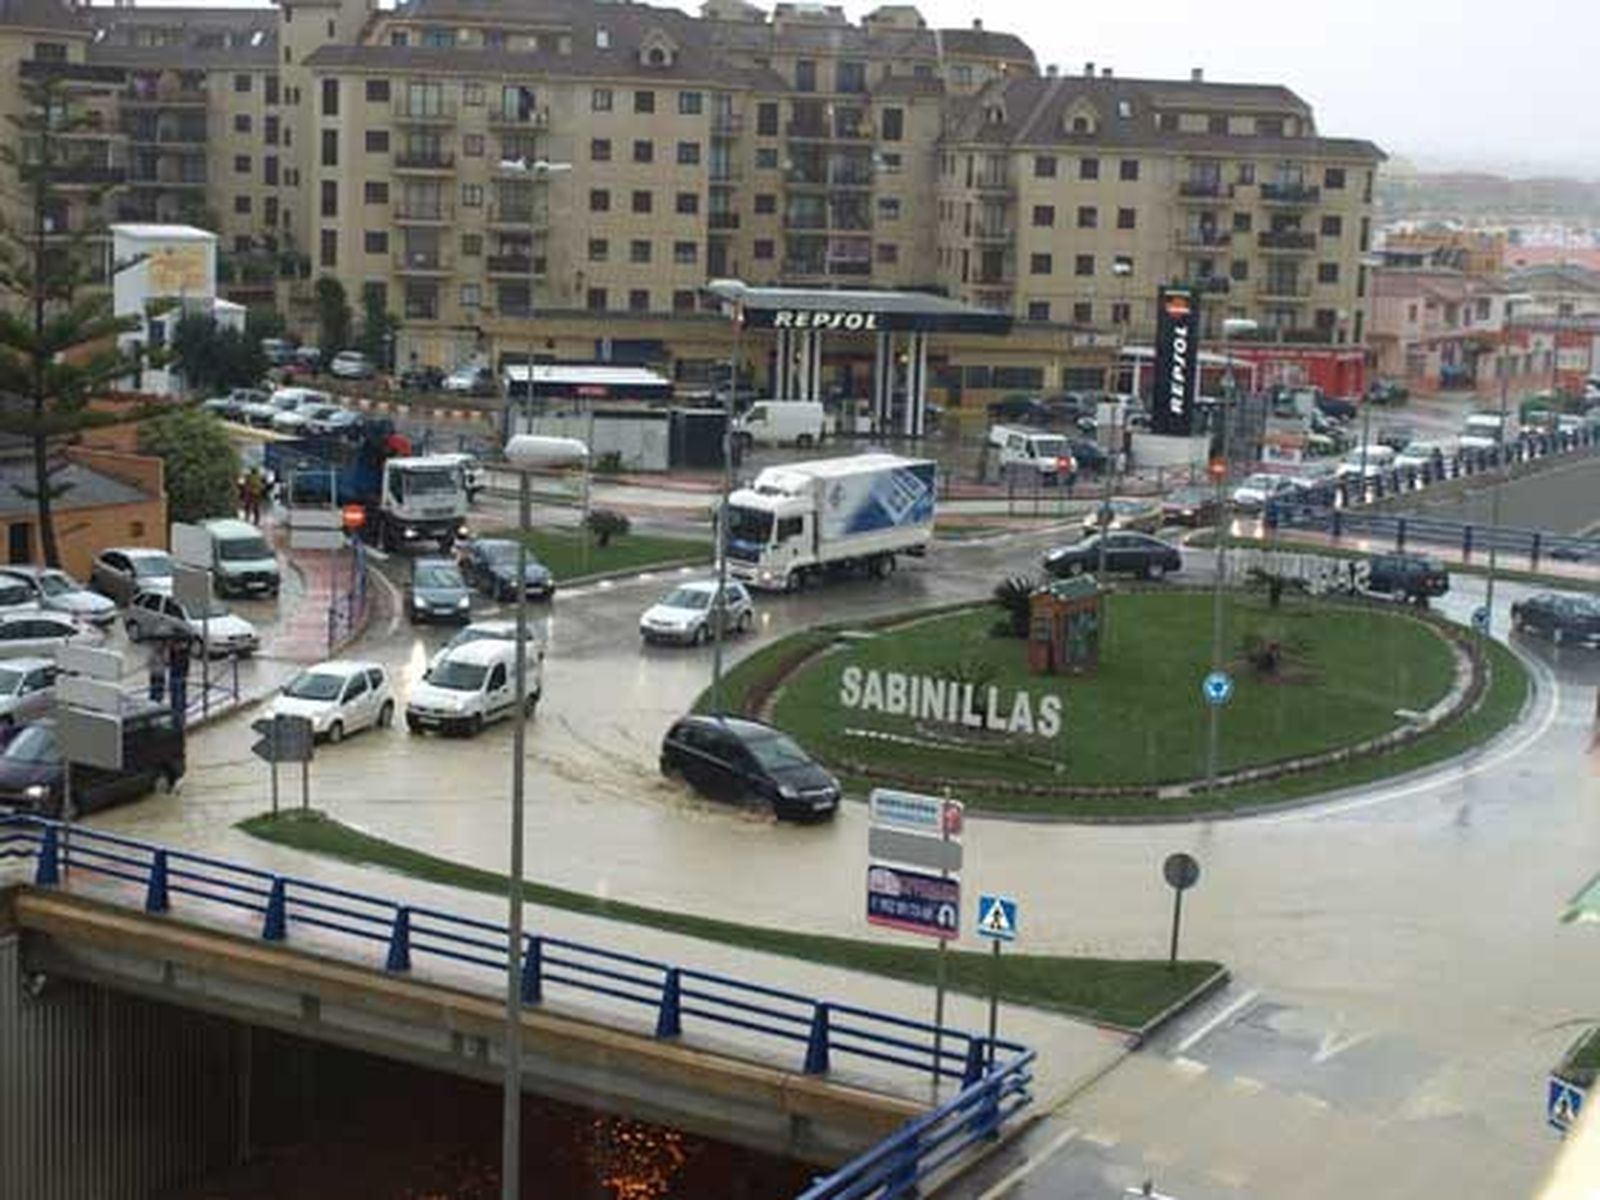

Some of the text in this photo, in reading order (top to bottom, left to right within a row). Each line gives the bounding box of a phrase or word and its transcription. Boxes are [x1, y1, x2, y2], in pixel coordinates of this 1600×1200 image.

[774, 311, 877, 331] REPSOL
[1169, 325, 1188, 415] REPSOL
[840, 665, 1063, 738] SABINILLAS
